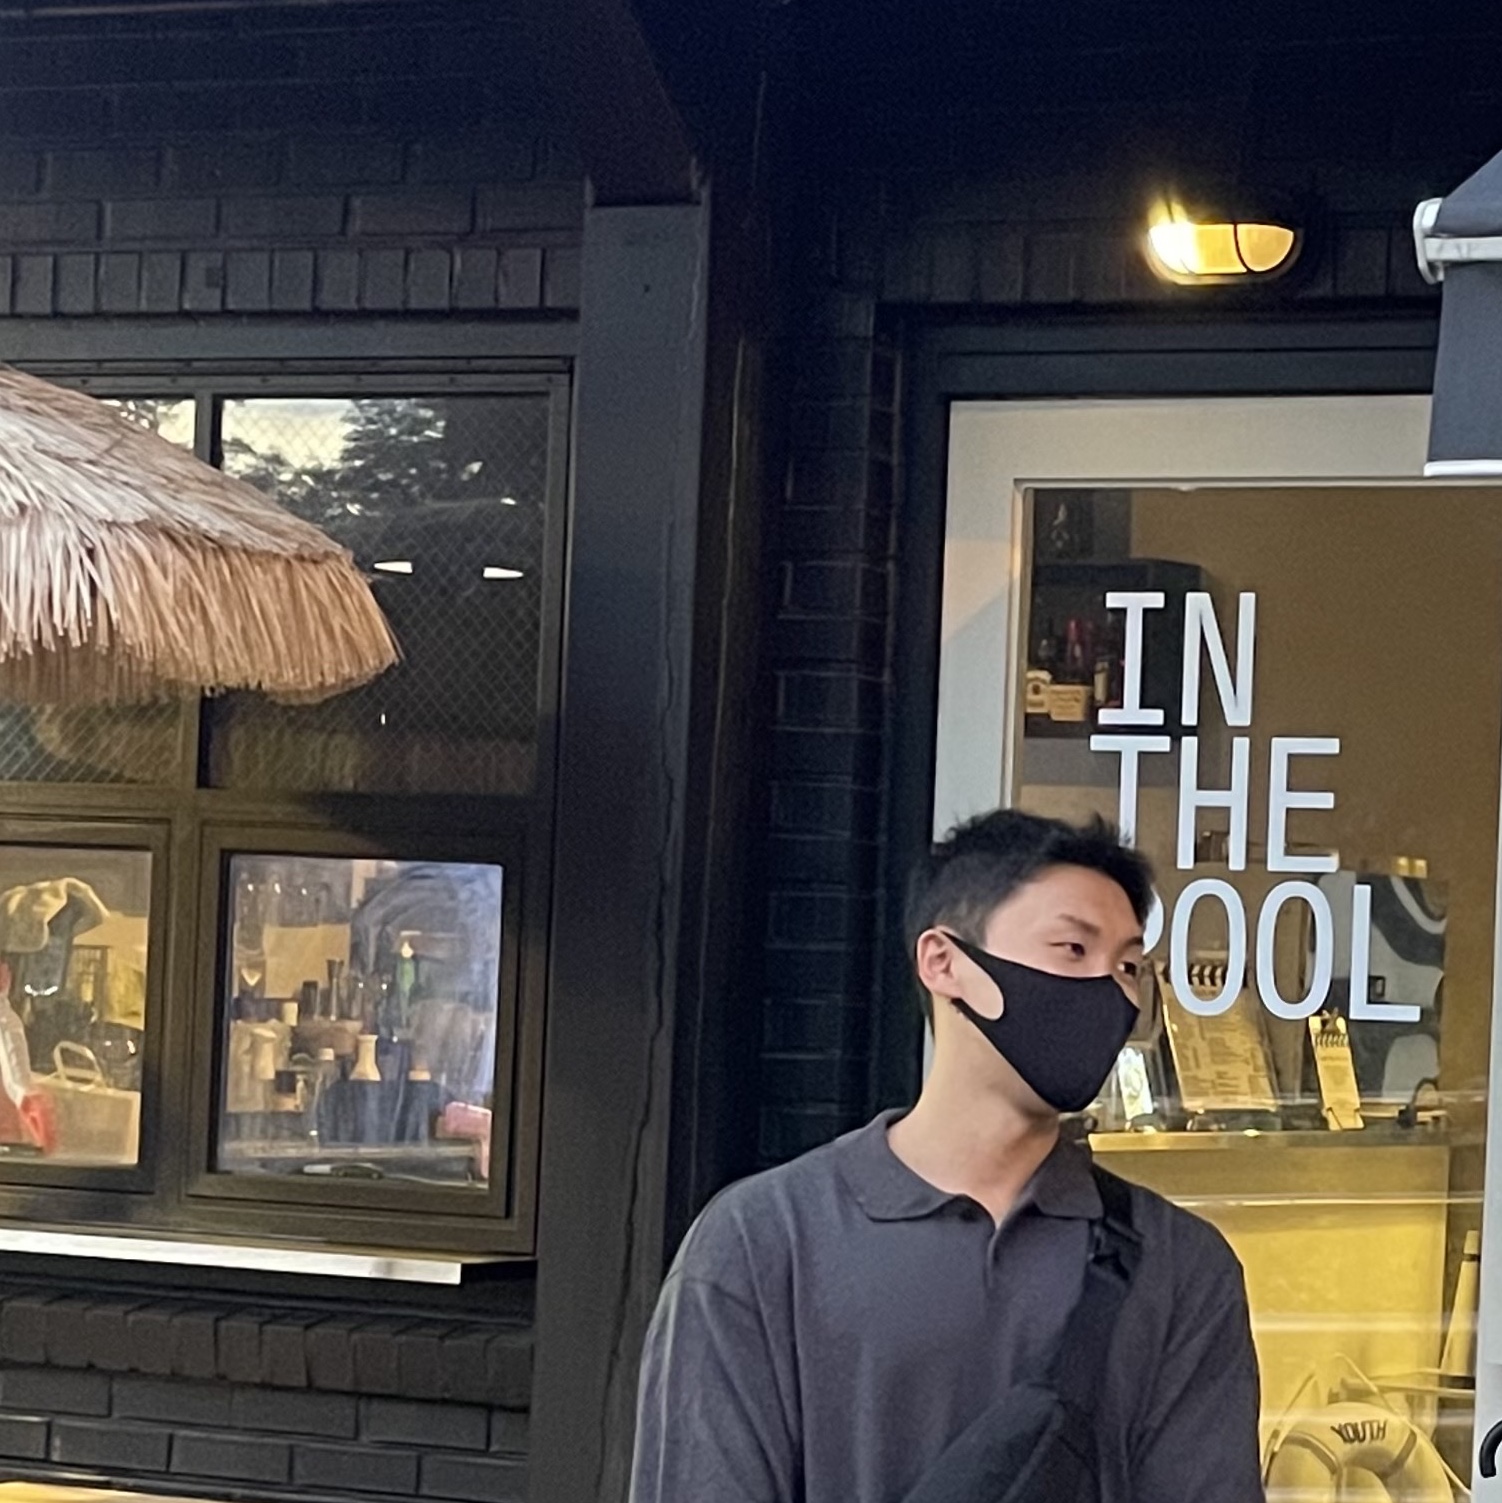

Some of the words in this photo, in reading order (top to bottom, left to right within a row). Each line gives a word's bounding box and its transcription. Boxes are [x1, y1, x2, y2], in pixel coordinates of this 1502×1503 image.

[1098, 591, 1256, 727] IN
[1090, 735, 1340, 873] THE
[1330, 1420, 1386, 1444] YOUTH
